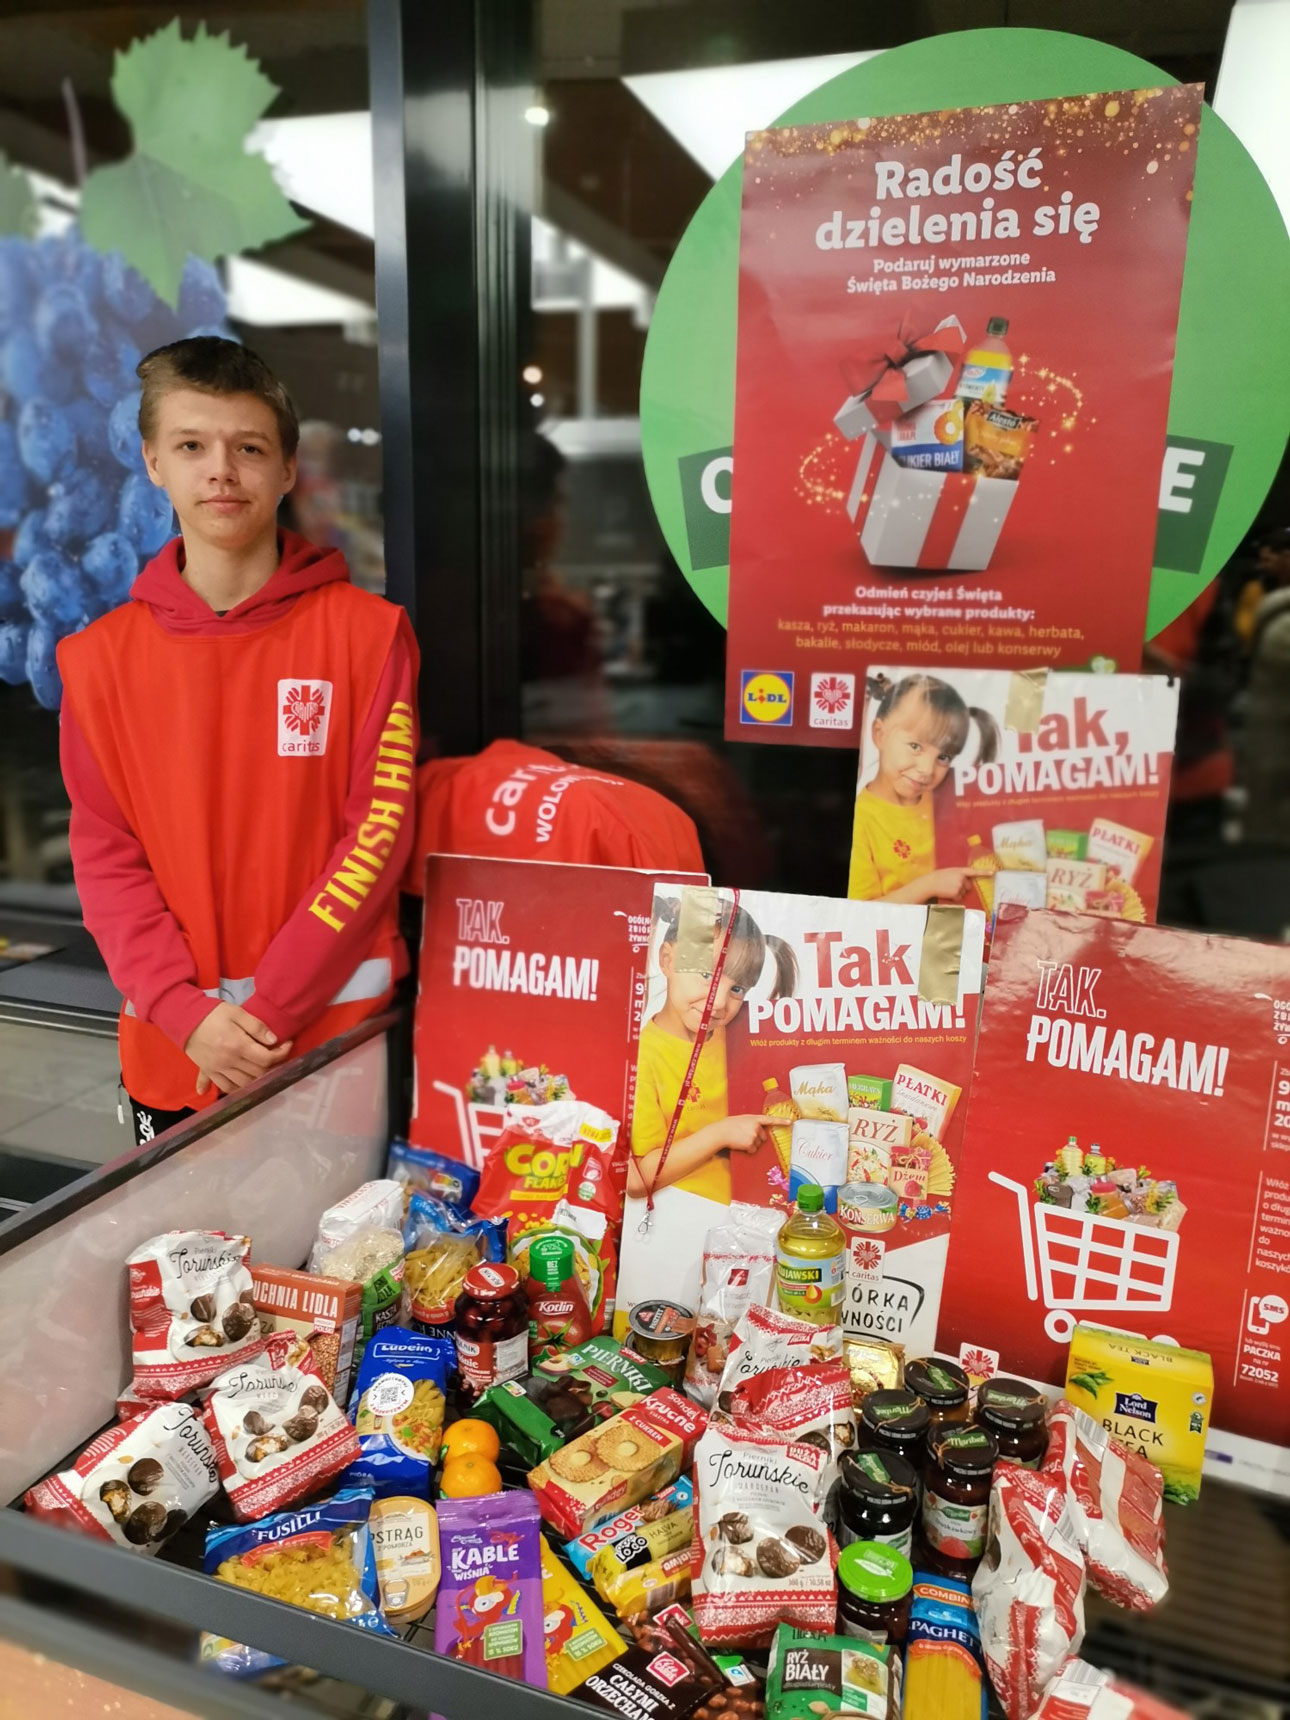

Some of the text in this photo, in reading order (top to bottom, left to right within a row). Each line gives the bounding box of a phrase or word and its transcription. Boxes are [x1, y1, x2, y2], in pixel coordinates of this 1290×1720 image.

[875, 148, 1044, 200] Radość
[815, 191, 1101, 250] dzielenia się
[873, 251, 1031, 273] Podaruj wymarzone
[847, 267, 1057, 296] Święta Bożego Narodzenia
[855, 585, 1003, 604] Odmień czyjeś Święta
[823, 603, 1036, 622] przekazując wybrane produkty:
[777, 620, 1085, 640] kasza, ryż, makaron, mąka, cukier, kawa, herbata,
[796, 636, 1061, 658] bakalie, słodycze, miód, olej lub konserwy
[813, 716, 849, 728] caritas
[953, 752, 1161, 797] POMAGAM!
[1092, 827, 1141, 855] PŁATKI
[308, 798, 406, 934] FINISH
[1051, 867, 1095, 890] RYŻ
[456, 898, 510, 945] TAK.
[804, 928, 915, 989] Tak
[453, 945, 600, 1002] POMAGAM!
[1036, 960, 1107, 1019] TAK.
[744, 992, 967, 1034] POMAGAM!
[750, 1038, 768, 1048] Włóż
[769, 1038, 800, 1048] produkty
[806, 1037, 831, 1047] długim
[832, 1037, 867, 1046] terminem
[868, 1036, 902, 1046] ważności
[903, 1036, 913, 1044] do
[914, 1035, 944, 1045] naszych
[945, 1034, 967, 1045] koszy
[1026, 1014, 1230, 1097] POMAGAM!
[794, 1081, 834, 1097] Mąka
[896, 1074, 948, 1107] PŁATKI
[852, 1118, 899, 1144] RYŻ
[798, 1137, 833, 1162] Cukier
[893, 1170, 926, 1182] Dżem
[839, 1205, 895, 1225] KONSERWA
[1258, 1235, 1270, 1245] do
[851, 1271, 880, 1281] caritas
[253, 1281, 298, 1316] UCHNIA
[302, 1290, 339, 1319] LIDLA
[852, 1283, 909, 1312] ÓRKA
[1263, 1303, 1285, 1315] SMS
[1134, 1349, 1173, 1363] BLACK
[1243, 1344, 1281, 1362] PACZKA
[581, 1343, 654, 1392] PIERNIKI
[1241, 1363, 1279, 1383] 72052
[1119, 1403, 1152, 1419] Nelson
[1124, 1397, 1147, 1410] Lord
[634, 1419, 664, 1441] CUKREM
[1102, 1418, 1164, 1446] BLACK
[709, 1449, 809, 1494] Toruńskie
[257, 1510, 321, 1542] FUSILLI
[579, 1504, 641, 1553] Roger
[649, 1521, 678, 1538] HALVA
[451, 1543, 520, 1570] KABLE
[454, 1563, 490, 1582] WIŚNIA
[787, 1648, 809, 1664] RYŻ
[785, 1663, 829, 1682] BIAŁY
[609, 1674, 659, 1713] CAŁYMI
